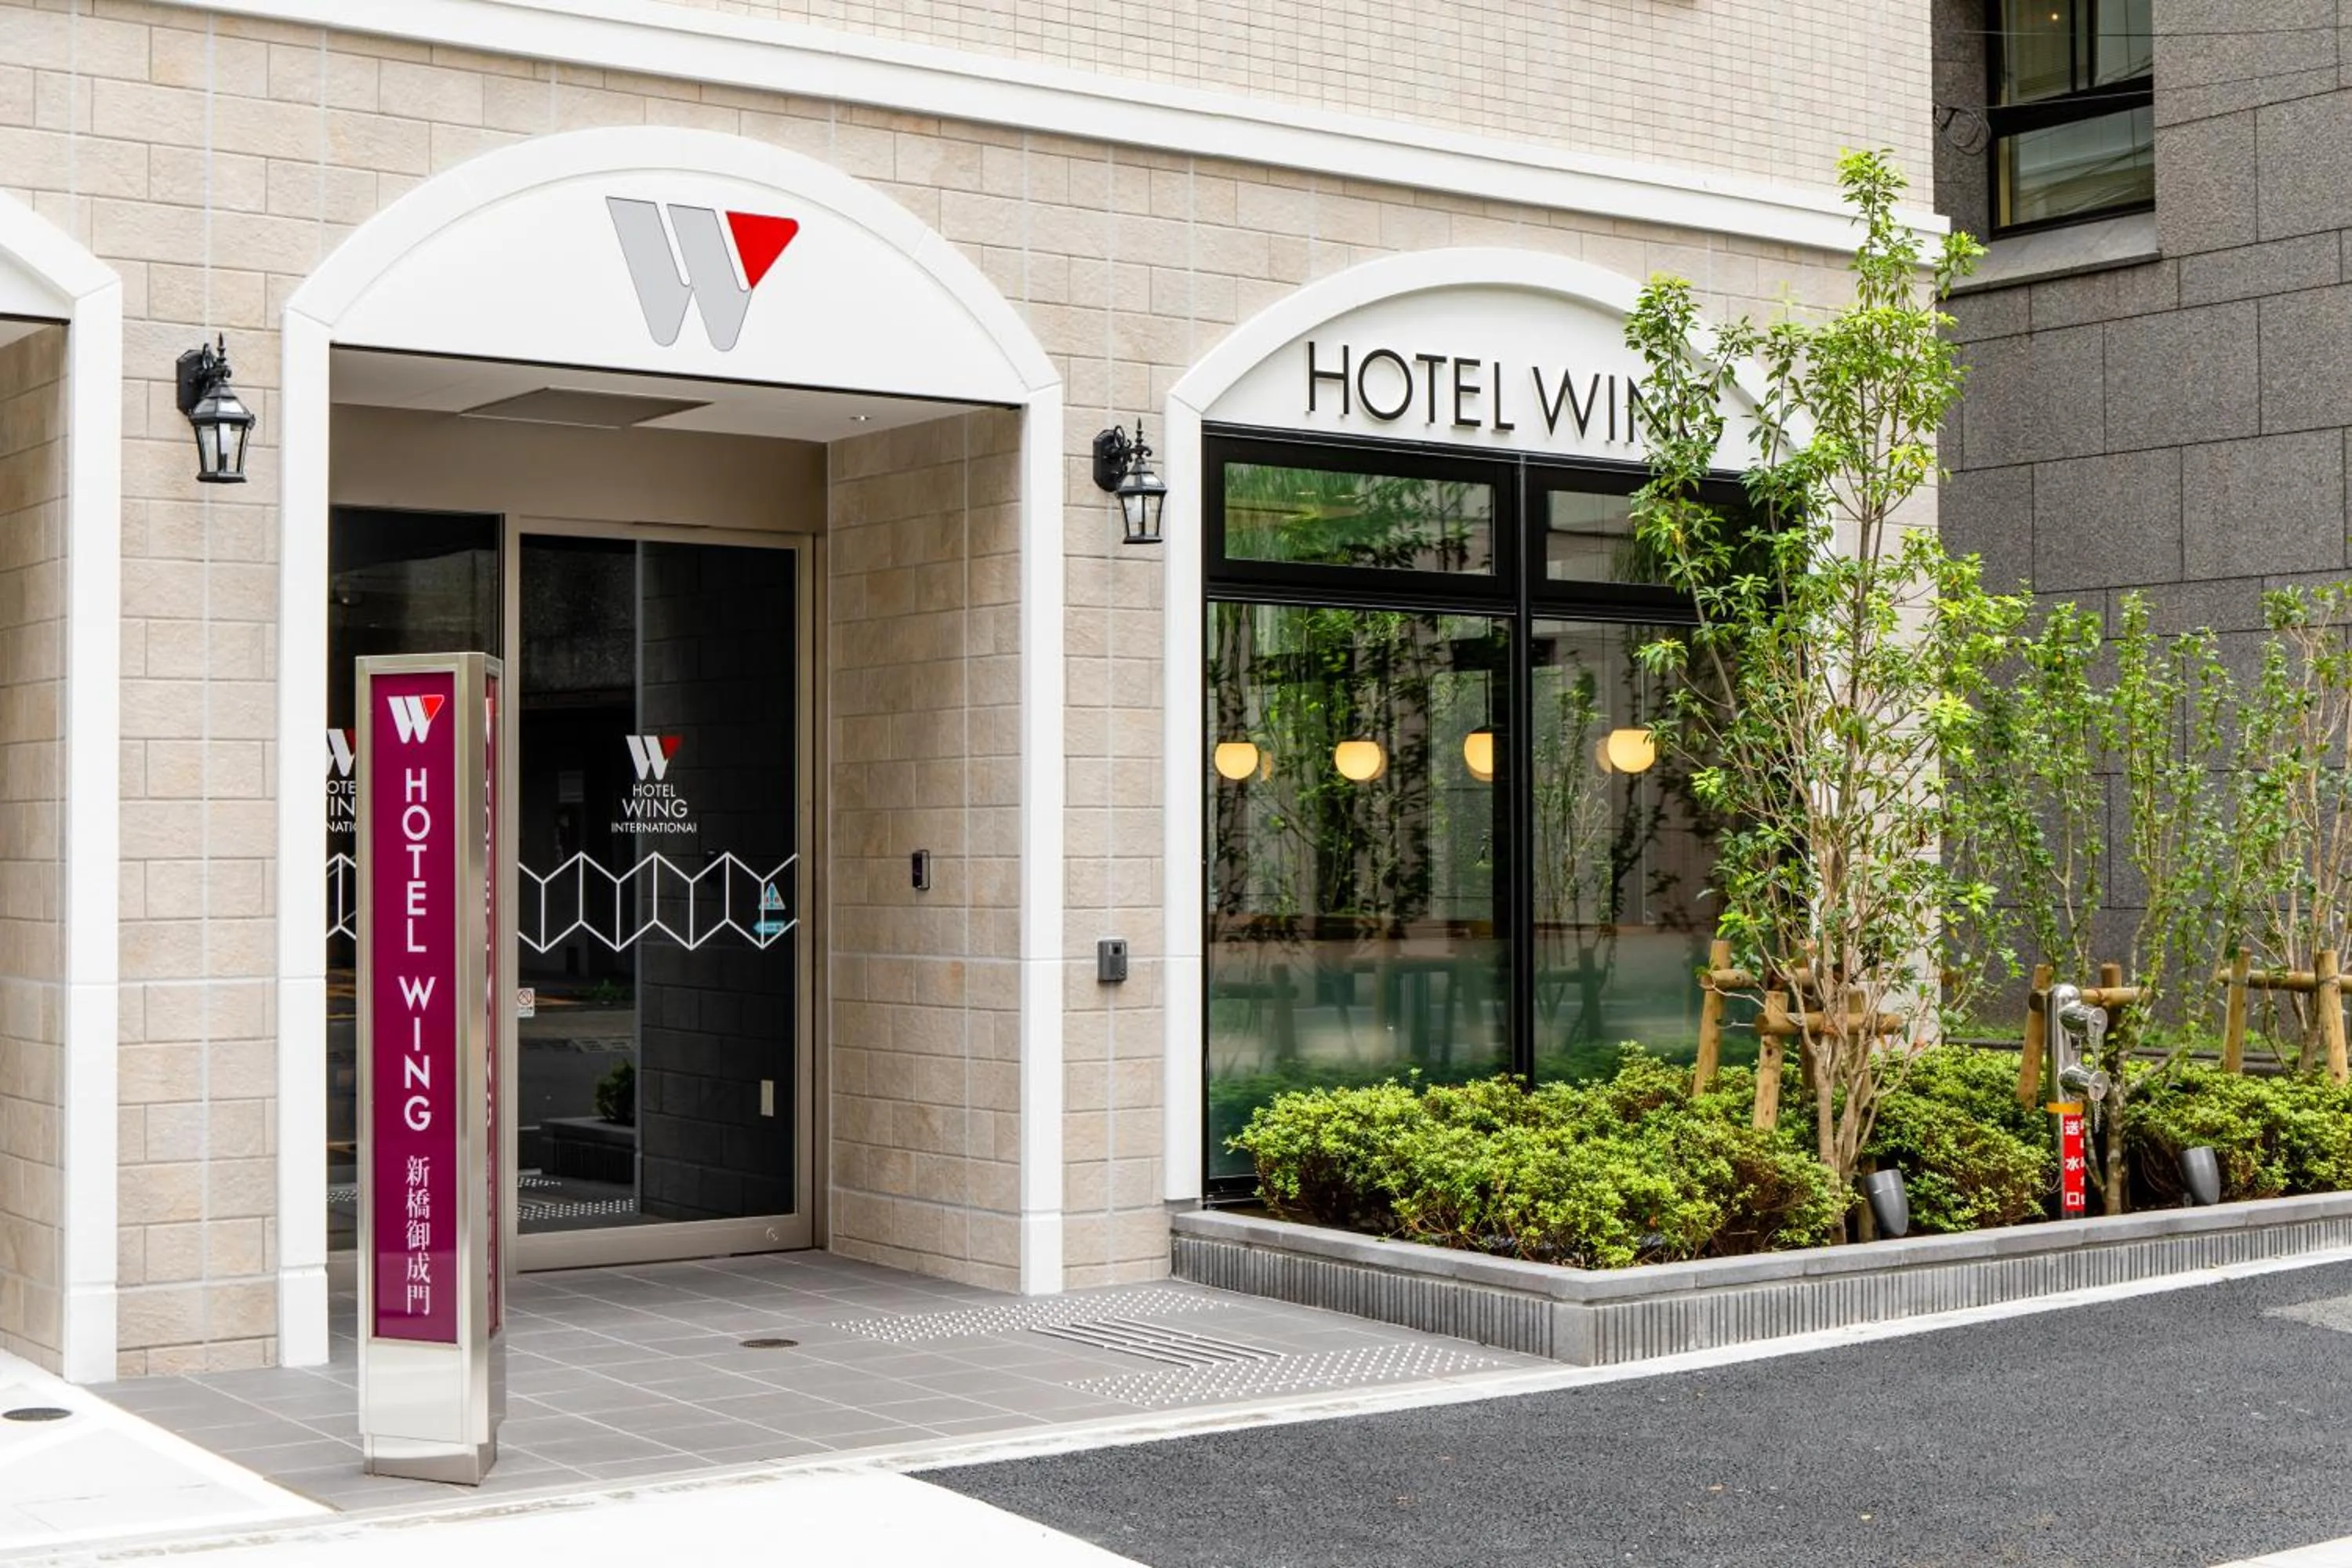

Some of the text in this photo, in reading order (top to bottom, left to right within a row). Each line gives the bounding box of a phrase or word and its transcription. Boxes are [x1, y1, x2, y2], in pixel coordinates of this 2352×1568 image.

[1307, 341, 1515, 431] HOTEL
[622, 798, 688, 818] WING
[633, 783, 677, 797] HOTEL
[397, 768, 436, 1131] HOTEL WING
[405, 1155, 430, 1316] 新橋御成門
